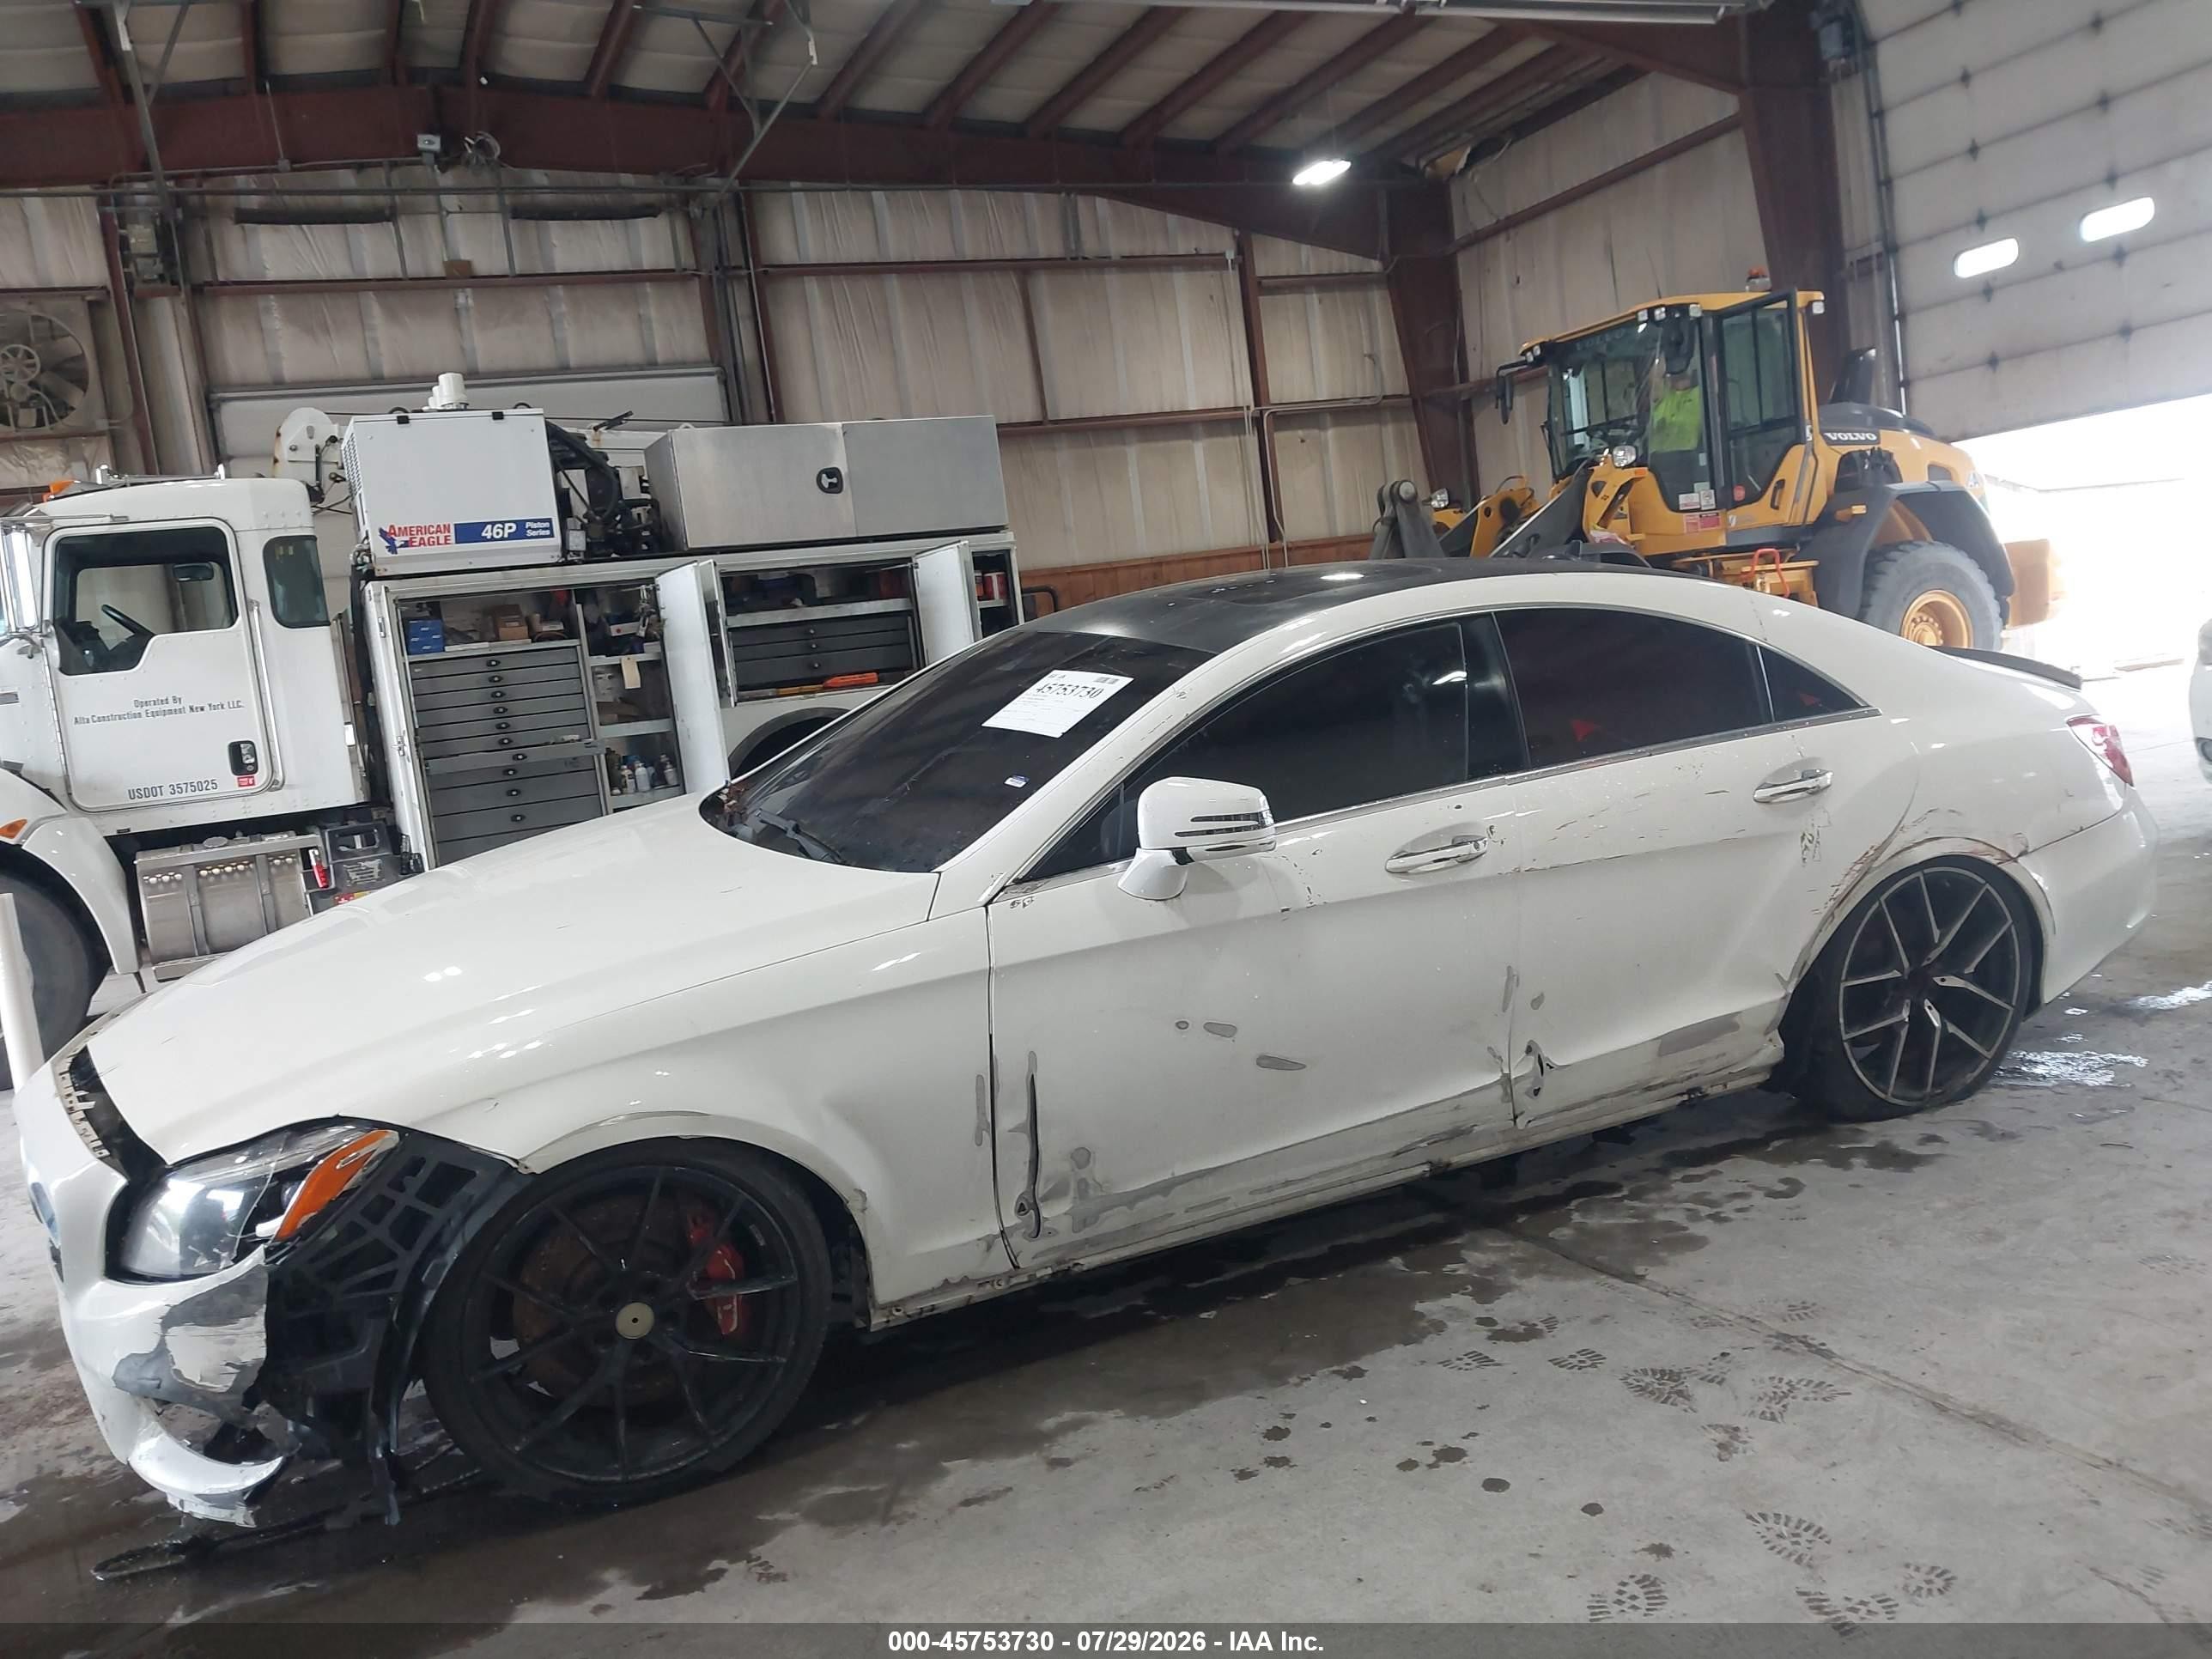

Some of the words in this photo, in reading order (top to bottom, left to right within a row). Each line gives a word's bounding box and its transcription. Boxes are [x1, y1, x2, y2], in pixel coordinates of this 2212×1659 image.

[1823, 432, 1877, 441] VOLVO
[388, 523, 451, 538] AMERICAN
[481, 523, 516, 539] 46P
[408, 536, 451, 548] EAGLE
[134, 696, 170, 708] Operated
[172, 696, 182, 704] By
[91, 711, 143, 723] Construction
[145, 706, 186, 718] Equipment
[208, 702, 225, 711] York
[128, 785, 164, 799] USDOT
[169, 779, 218, 795] 3575025
